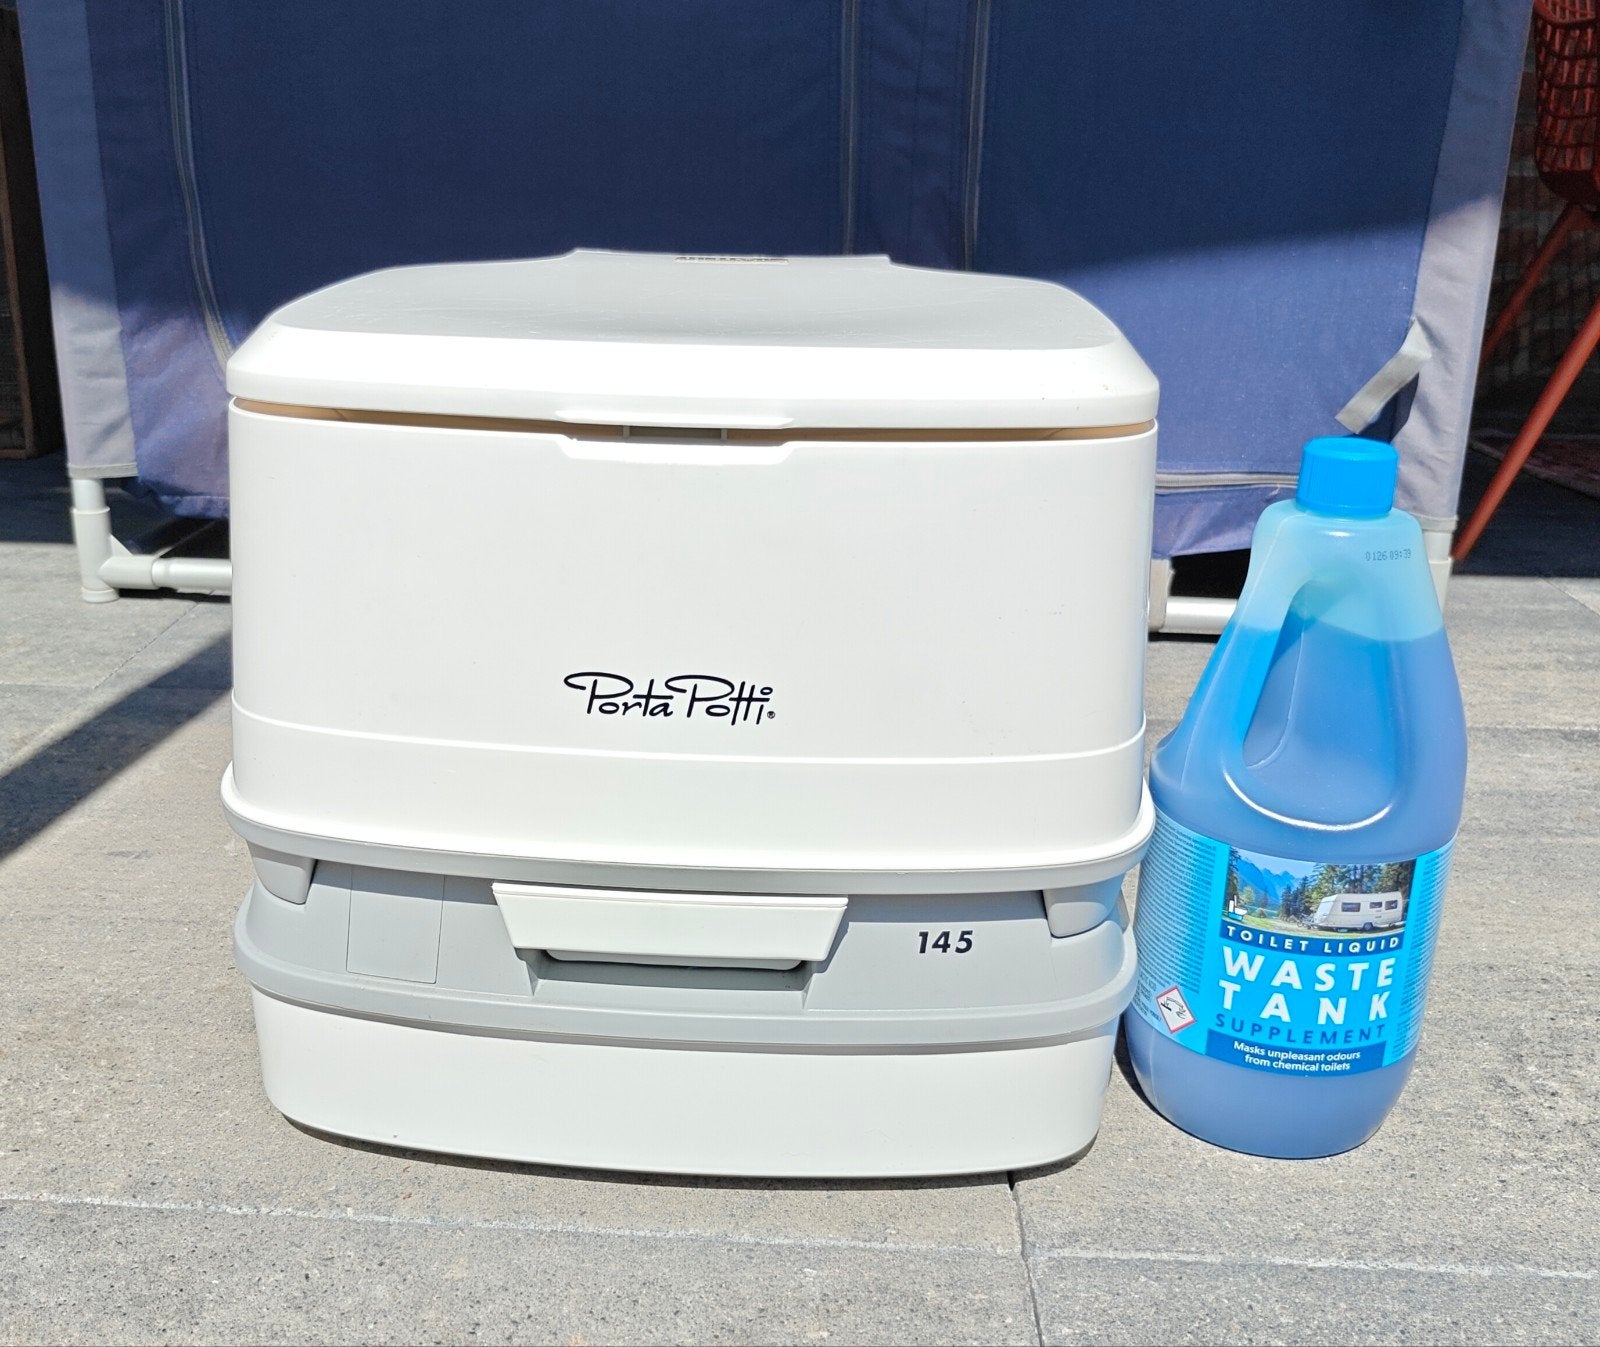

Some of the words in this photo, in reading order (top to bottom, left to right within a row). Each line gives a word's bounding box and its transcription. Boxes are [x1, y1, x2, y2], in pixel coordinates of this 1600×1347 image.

[563, 671, 674, 717] Porta
[918, 930, 974, 954] 145
[1226, 925, 1310, 952] TOILET
[1323, 936, 1400, 954] LIQUID
[1222, 945, 1397, 992] WASTE
[1218, 979, 1392, 1025] TANK
[1215, 1012, 1387, 1045] SUPPLEMENT
[1233, 1040, 1266, 1056] Masks
[1267, 1048, 1325, 1062] unpleasant
[1326, 1050, 1361, 1062] odours
[1244, 1054, 1271, 1068] from
[1272, 1060, 1319, 1072] chemical
[1320, 1061, 1351, 1072] toilets
